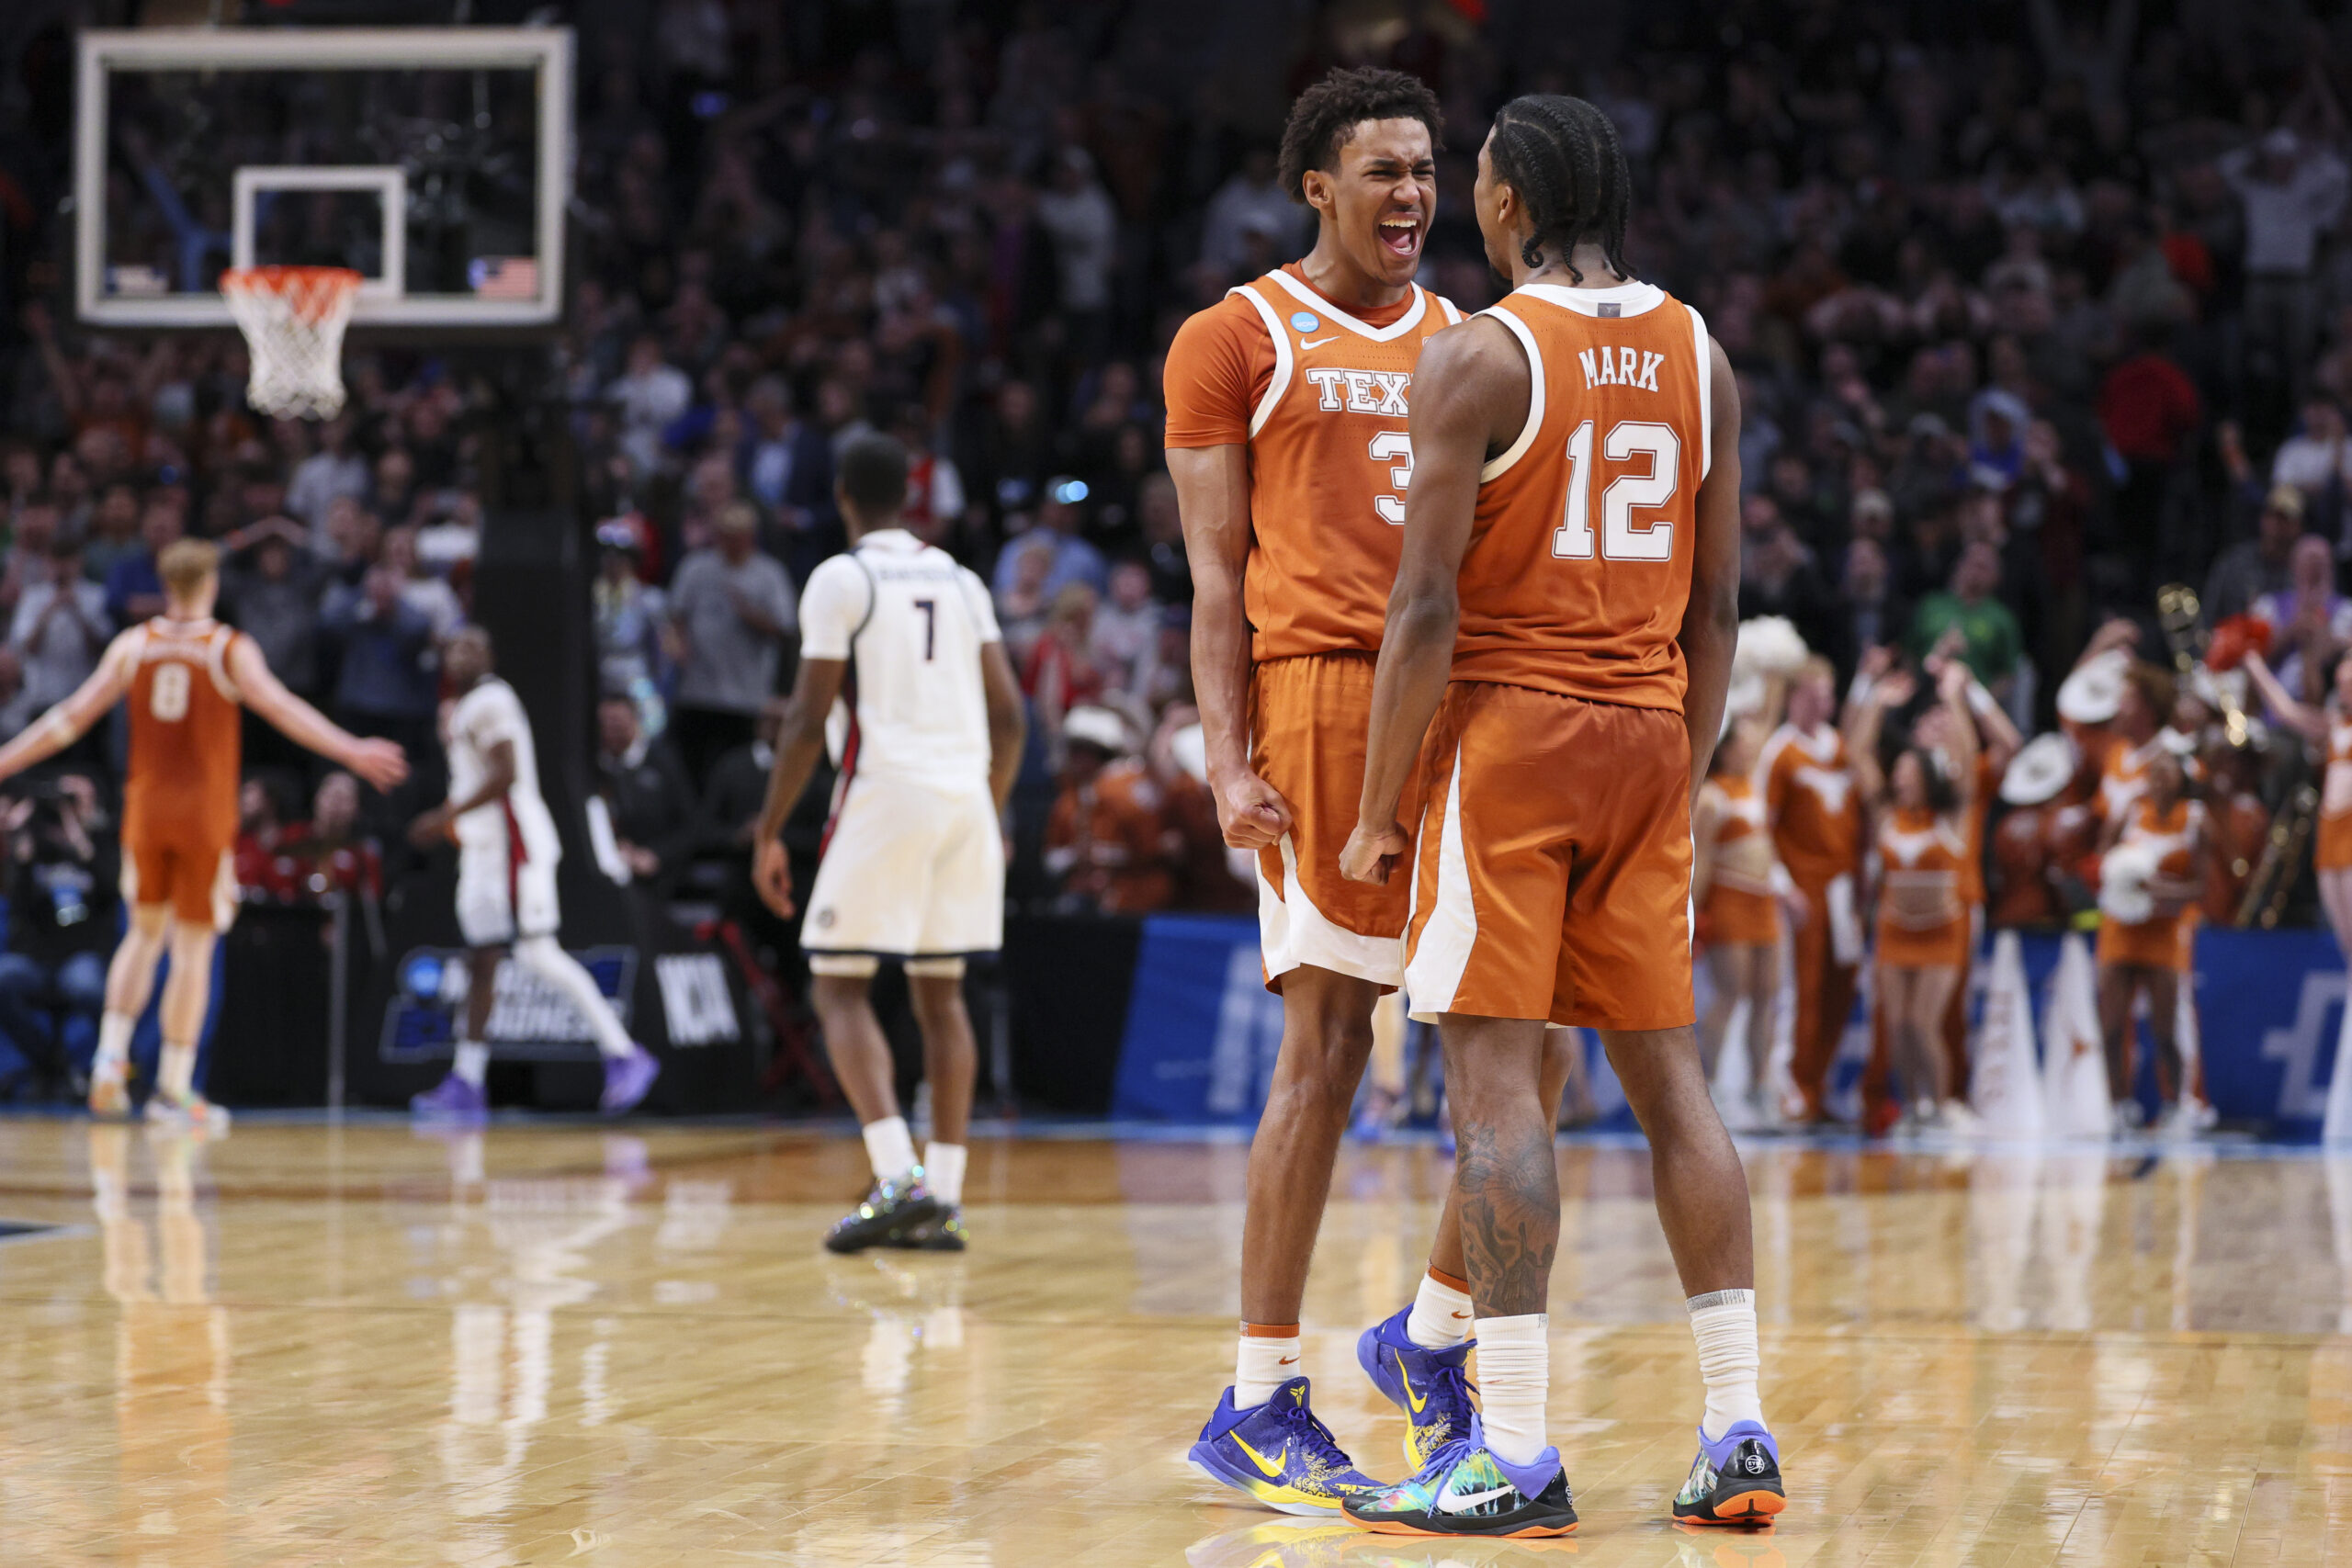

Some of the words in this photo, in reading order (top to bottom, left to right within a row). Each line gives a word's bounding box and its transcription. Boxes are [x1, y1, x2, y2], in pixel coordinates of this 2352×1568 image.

[1306, 367, 1413, 418] TEX
[1578, 345, 1665, 393] MARK
[1368, 430, 1415, 525] 3
[1552, 420, 1680, 562] 12
